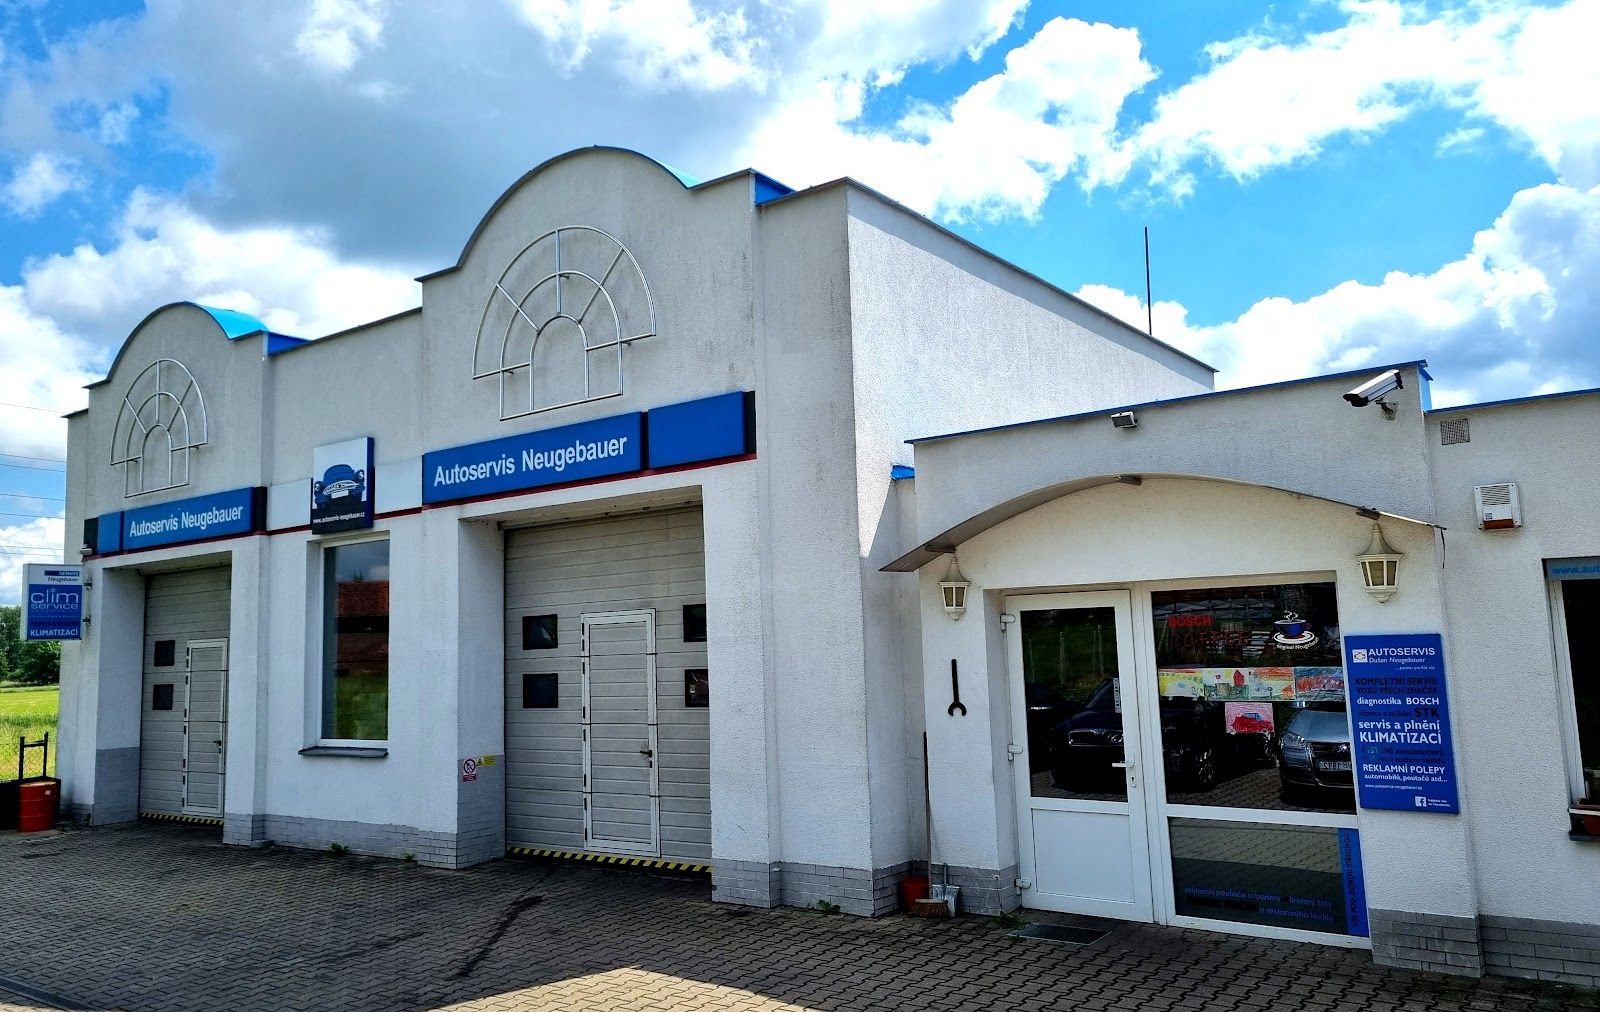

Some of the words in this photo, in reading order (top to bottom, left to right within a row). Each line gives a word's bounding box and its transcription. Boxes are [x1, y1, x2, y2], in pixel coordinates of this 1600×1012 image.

[434, 454, 515, 487] Autoservis
[522, 437, 628, 472] Neugebauer
[129, 516, 179, 537] Autoservis
[181, 506, 243, 530] Neugebauer
[30, 588, 79, 604] clim
[1168, 616, 1212, 628] BOSCH
[1368, 648, 1436, 656] AUTOSERVIS
[1357, 697, 1402, 706] diagnostika
[1405, 697, 1440, 705] BOSCH
[1358, 719, 1391, 729] servis
[1404, 720, 1441, 732] plnění
[1359, 731, 1442, 744] KLIMATIZACÍ
[1362, 764, 1408, 773] REKLAMNÍ
[1410, 765, 1445, 774] POLEPY
